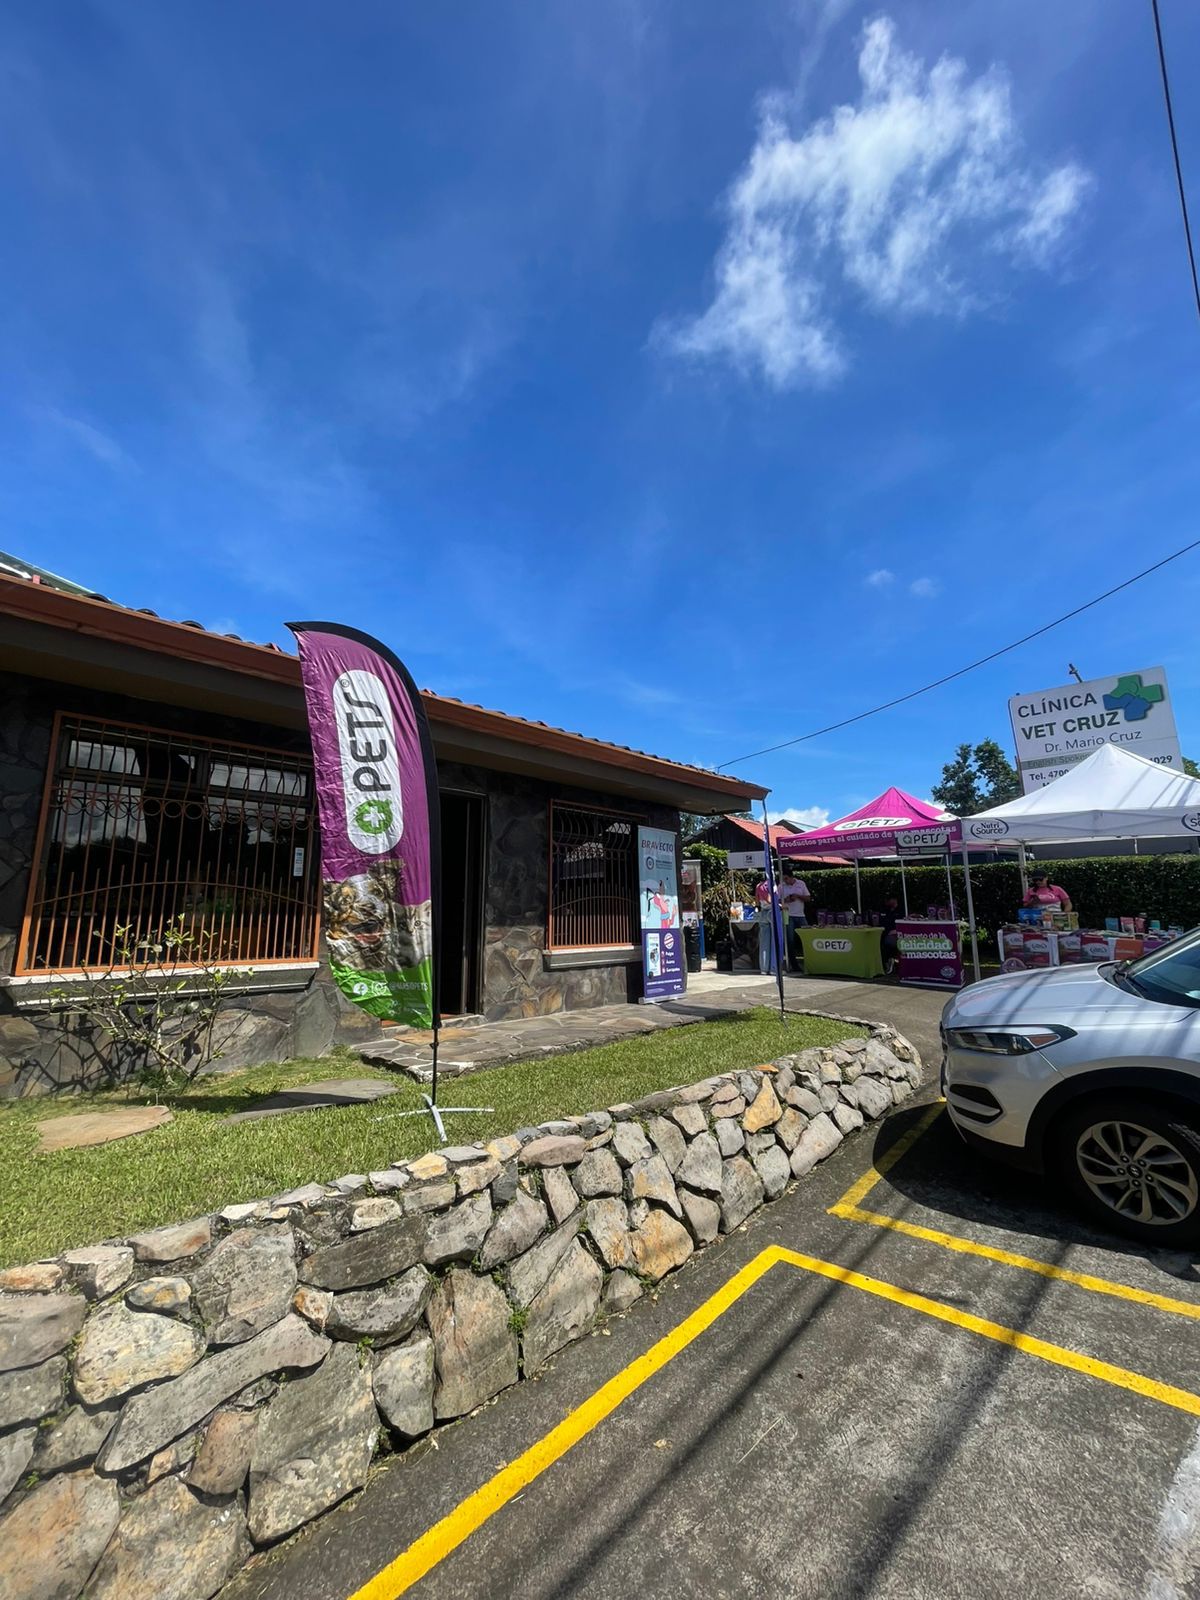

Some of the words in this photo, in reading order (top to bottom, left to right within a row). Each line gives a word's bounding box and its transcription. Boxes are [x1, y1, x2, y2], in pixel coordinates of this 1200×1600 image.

[1017, 692, 1098, 718] CLÍNICA
[1021, 722, 1057, 740] VET
[1063, 711, 1120, 733] CRUZ
[342, 692, 392, 792] PETS
[1045, 742, 1062, 753] Dr.
[1066, 736, 1105, 750] Mario
[1109, 731, 1142, 743] Cruz
[1030, 772, 1046, 781] Tel.
[1149, 754, 1173, 764] 029
[857, 819, 901, 828] PETS
[981, 821, 999, 829] Nutri
[976, 827, 1003, 835] Source
[780, 839, 817, 848] Productos
[818, 837, 836, 846] para
[837, 835, 845, 843] el
[846, 832, 879, 842] cuidado
[881, 830, 892, 839] de
[914, 833, 939, 844] PETS
[824, 940, 847, 950] PETS
[900, 939, 950, 951] felicidad
[906, 950, 957, 959] mascotas
